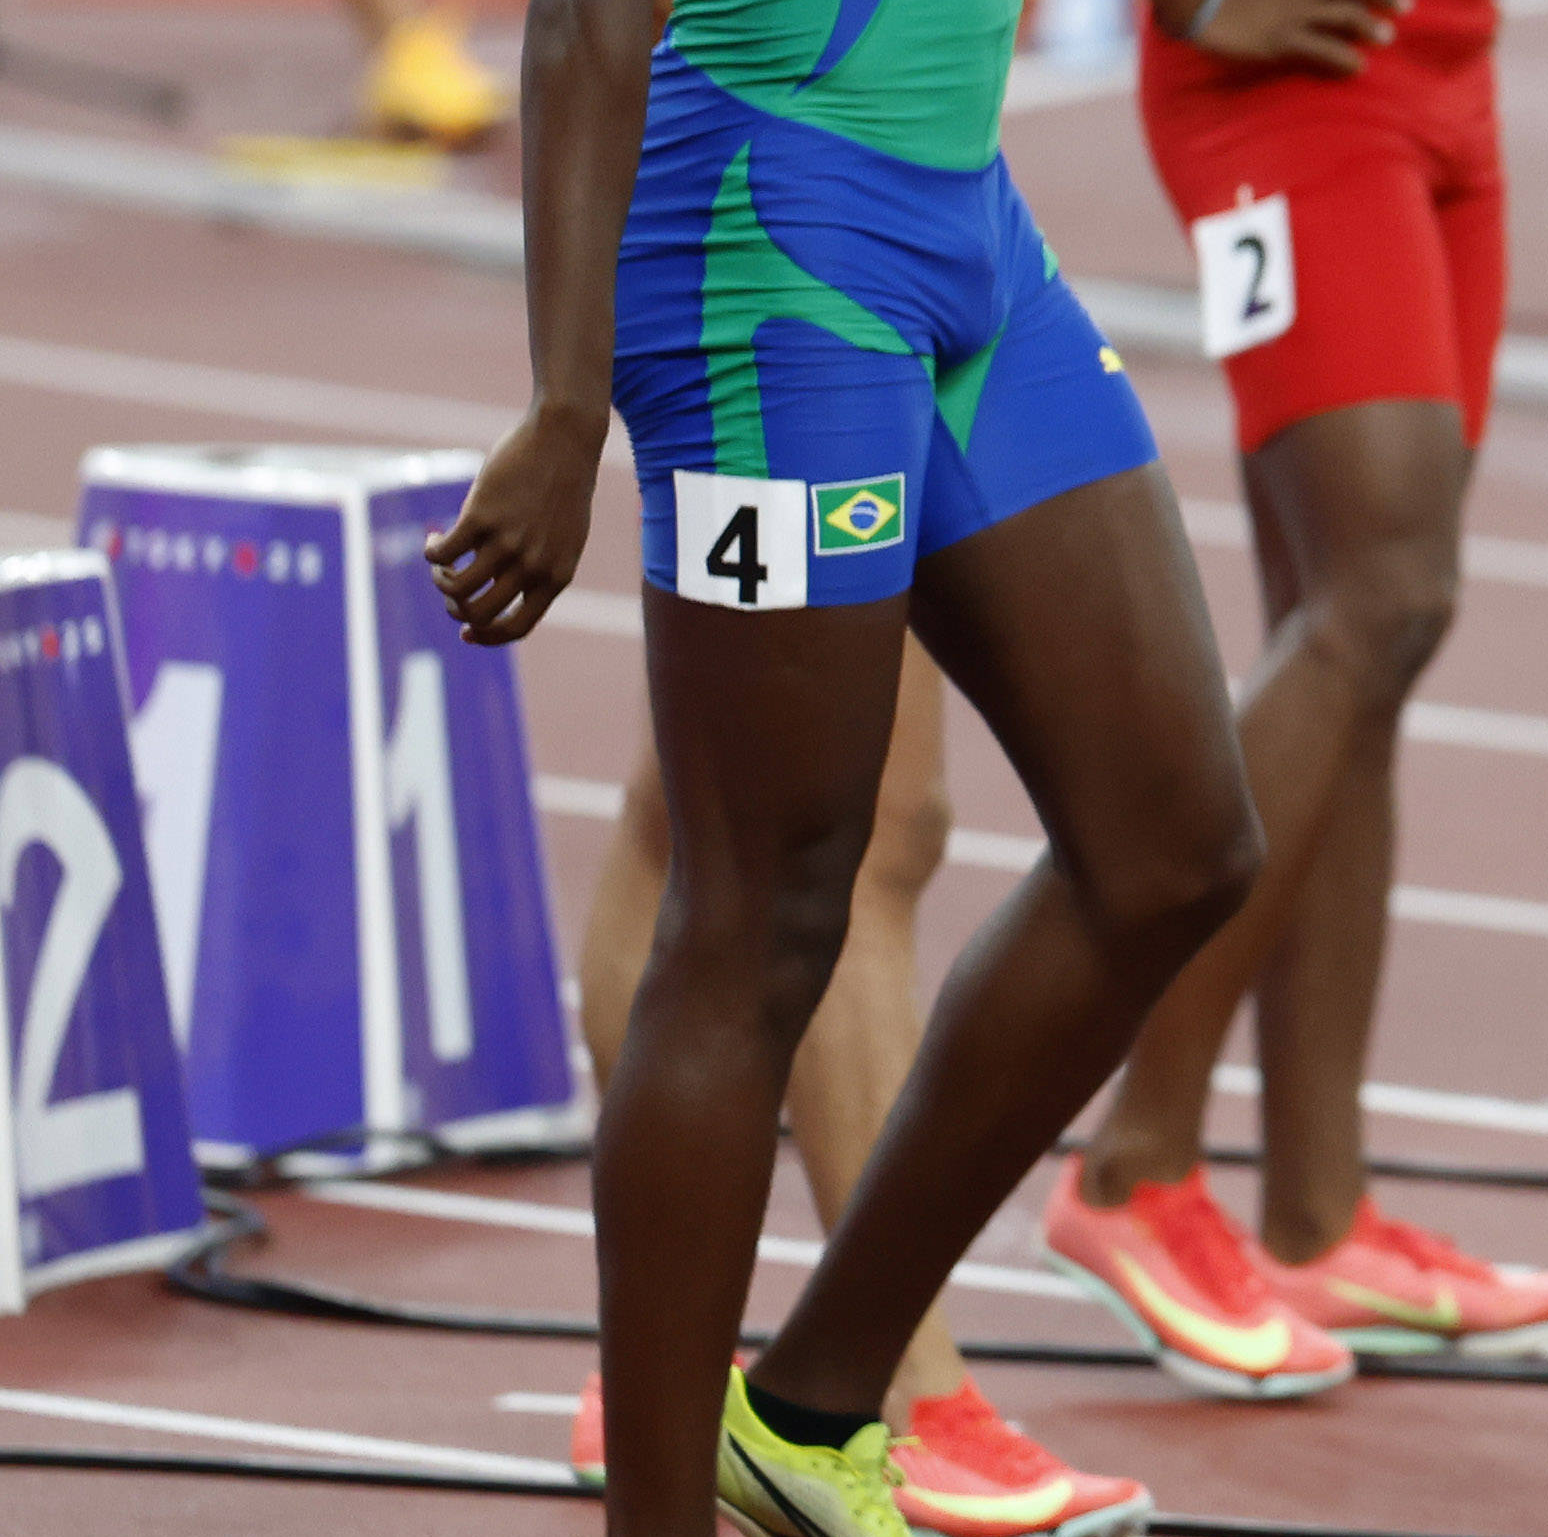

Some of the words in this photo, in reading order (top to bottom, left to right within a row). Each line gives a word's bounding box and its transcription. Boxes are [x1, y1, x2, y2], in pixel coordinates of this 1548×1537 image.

[1234, 233, 1273, 320] 2
[706, 504, 768, 604] 4
[0, 756, 147, 1199] 2
[386, 651, 475, 1062] 1
